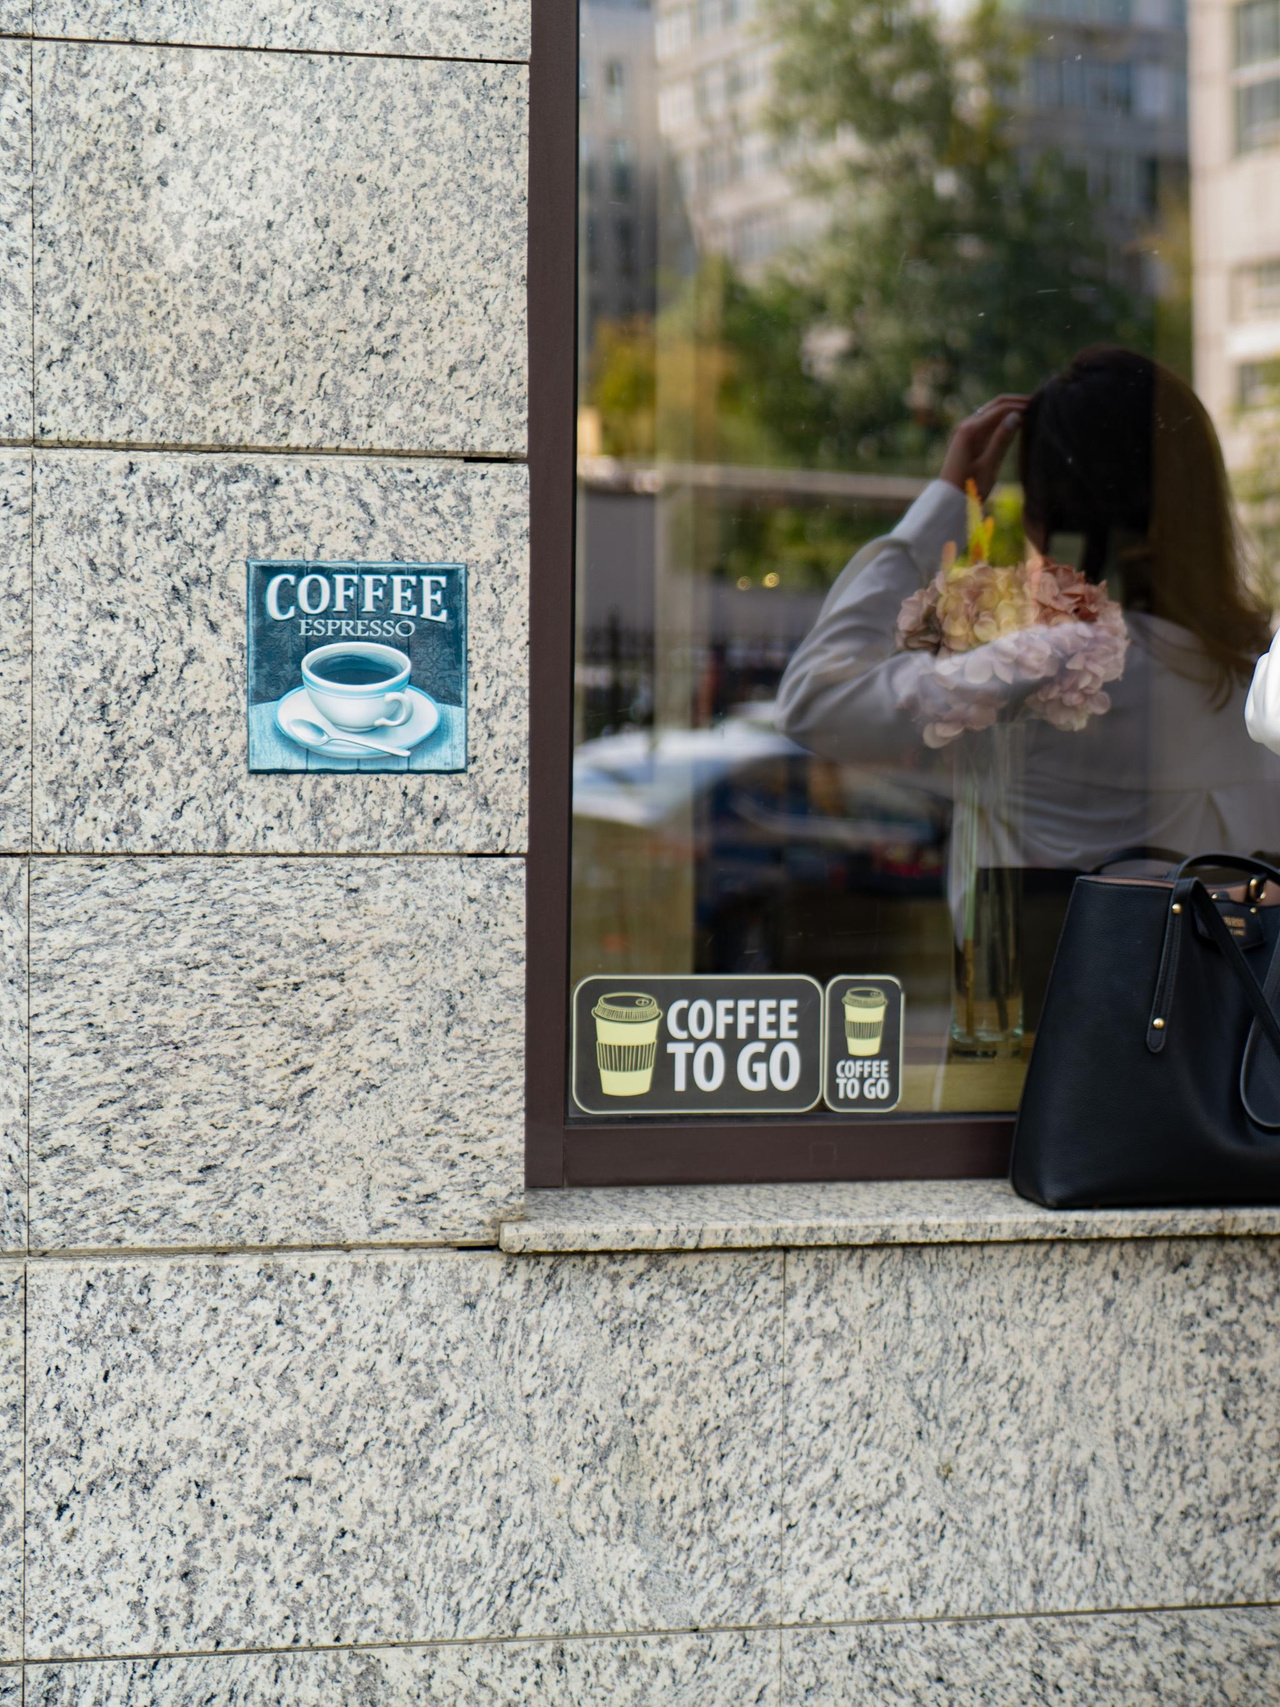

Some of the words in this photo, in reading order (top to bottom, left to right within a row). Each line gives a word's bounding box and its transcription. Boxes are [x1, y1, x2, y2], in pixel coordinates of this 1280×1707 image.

[266, 573, 447, 622] COFFEE
[299, 619, 415, 637] ESPRESSO
[667, 1000, 798, 1039] COFFEE
[666, 1042, 725, 1092] TO
[736, 1041, 801, 1092] GO
[835, 1060, 889, 1078] COFFEE
[835, 1078, 859, 1100] TO
[863, 1078, 890, 1100] GO
